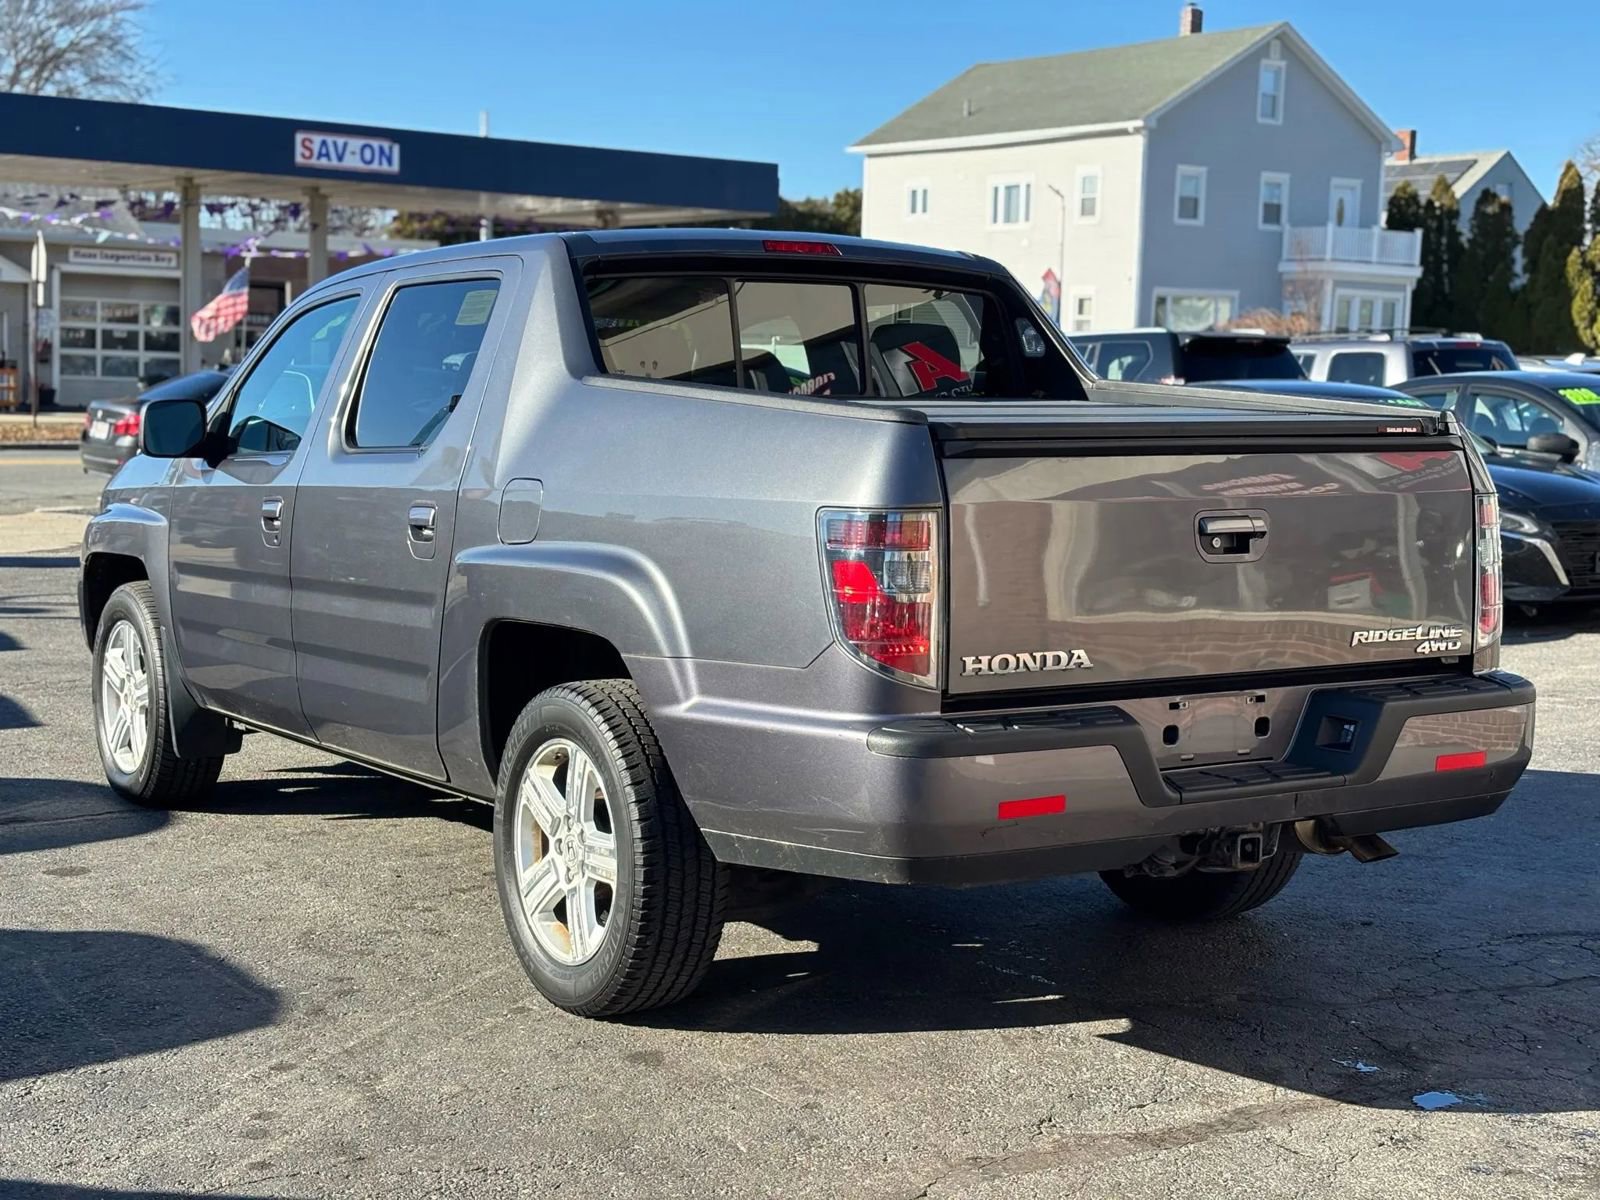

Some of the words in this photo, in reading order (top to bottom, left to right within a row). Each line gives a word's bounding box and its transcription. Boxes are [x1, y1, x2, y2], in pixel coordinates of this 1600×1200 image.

[300, 136, 394, 168] SAV-ON
[1351, 623, 1464, 647] RIDGELINE
[1415, 639, 1463, 655] 4WD
[961, 648, 1094, 677] HONDA
